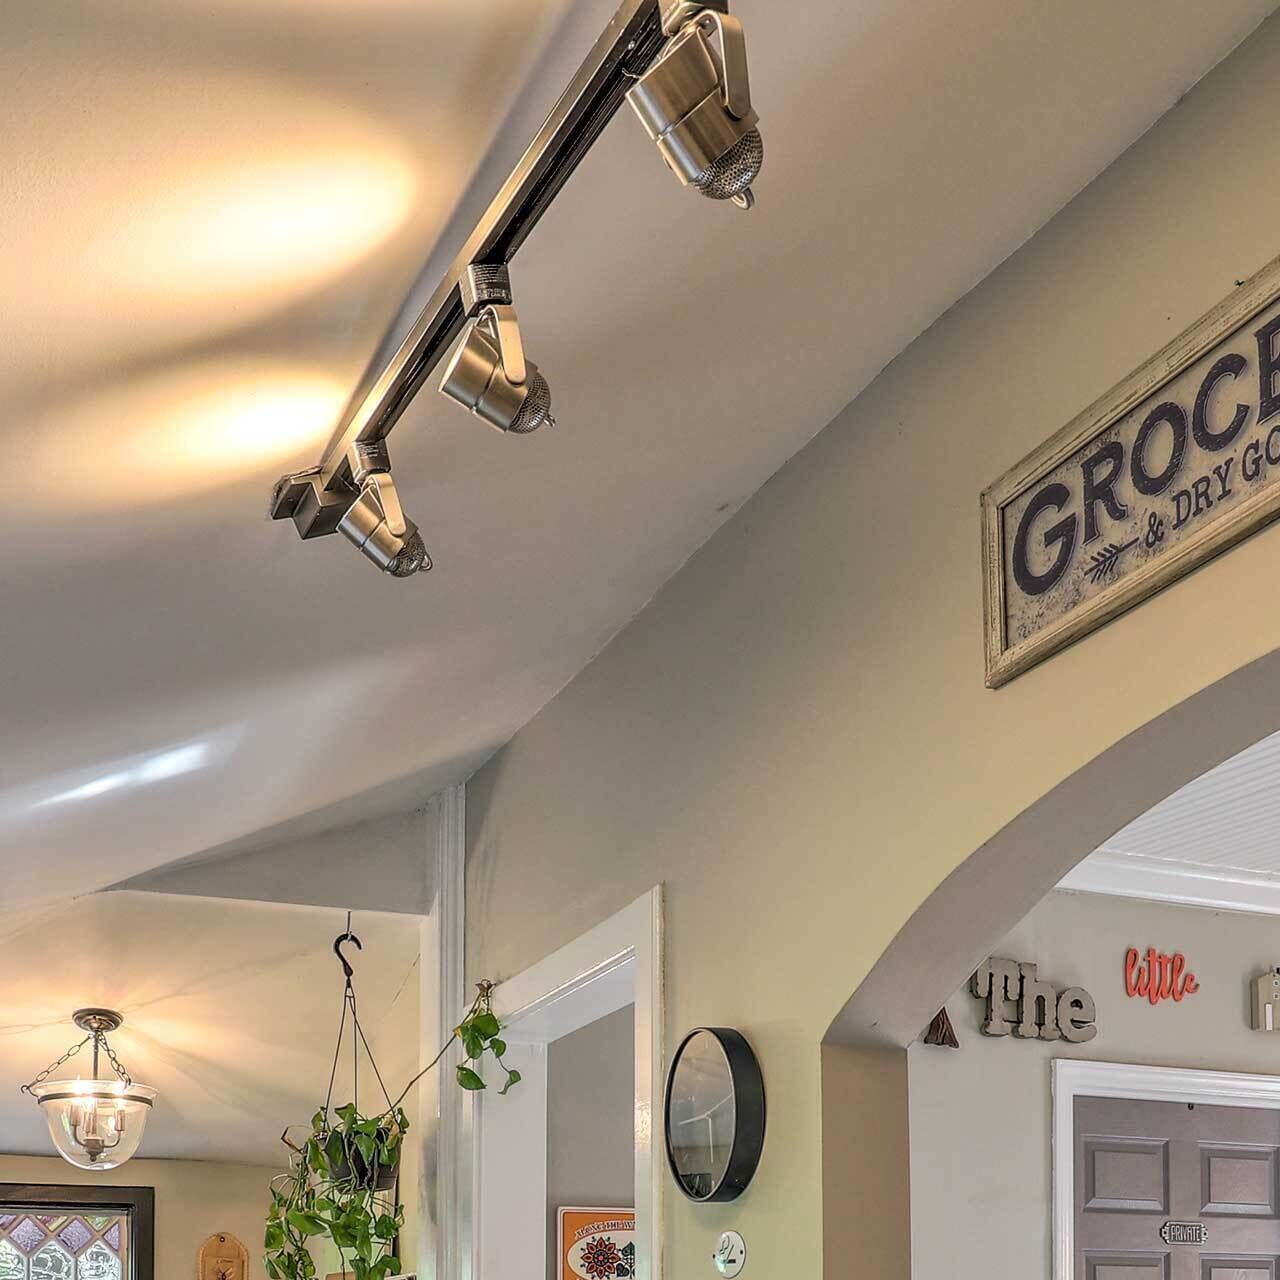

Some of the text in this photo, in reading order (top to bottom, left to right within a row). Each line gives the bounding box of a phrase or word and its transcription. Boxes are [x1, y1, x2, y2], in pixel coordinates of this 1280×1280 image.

[1144, 511, 1166, 550] &
[1171, 458, 1233, 534] DRY
[970, 956, 1098, 1044] The
[1124, 947, 1201, 1006] little
[1170, 1225, 1201, 1242] PRIVATE
